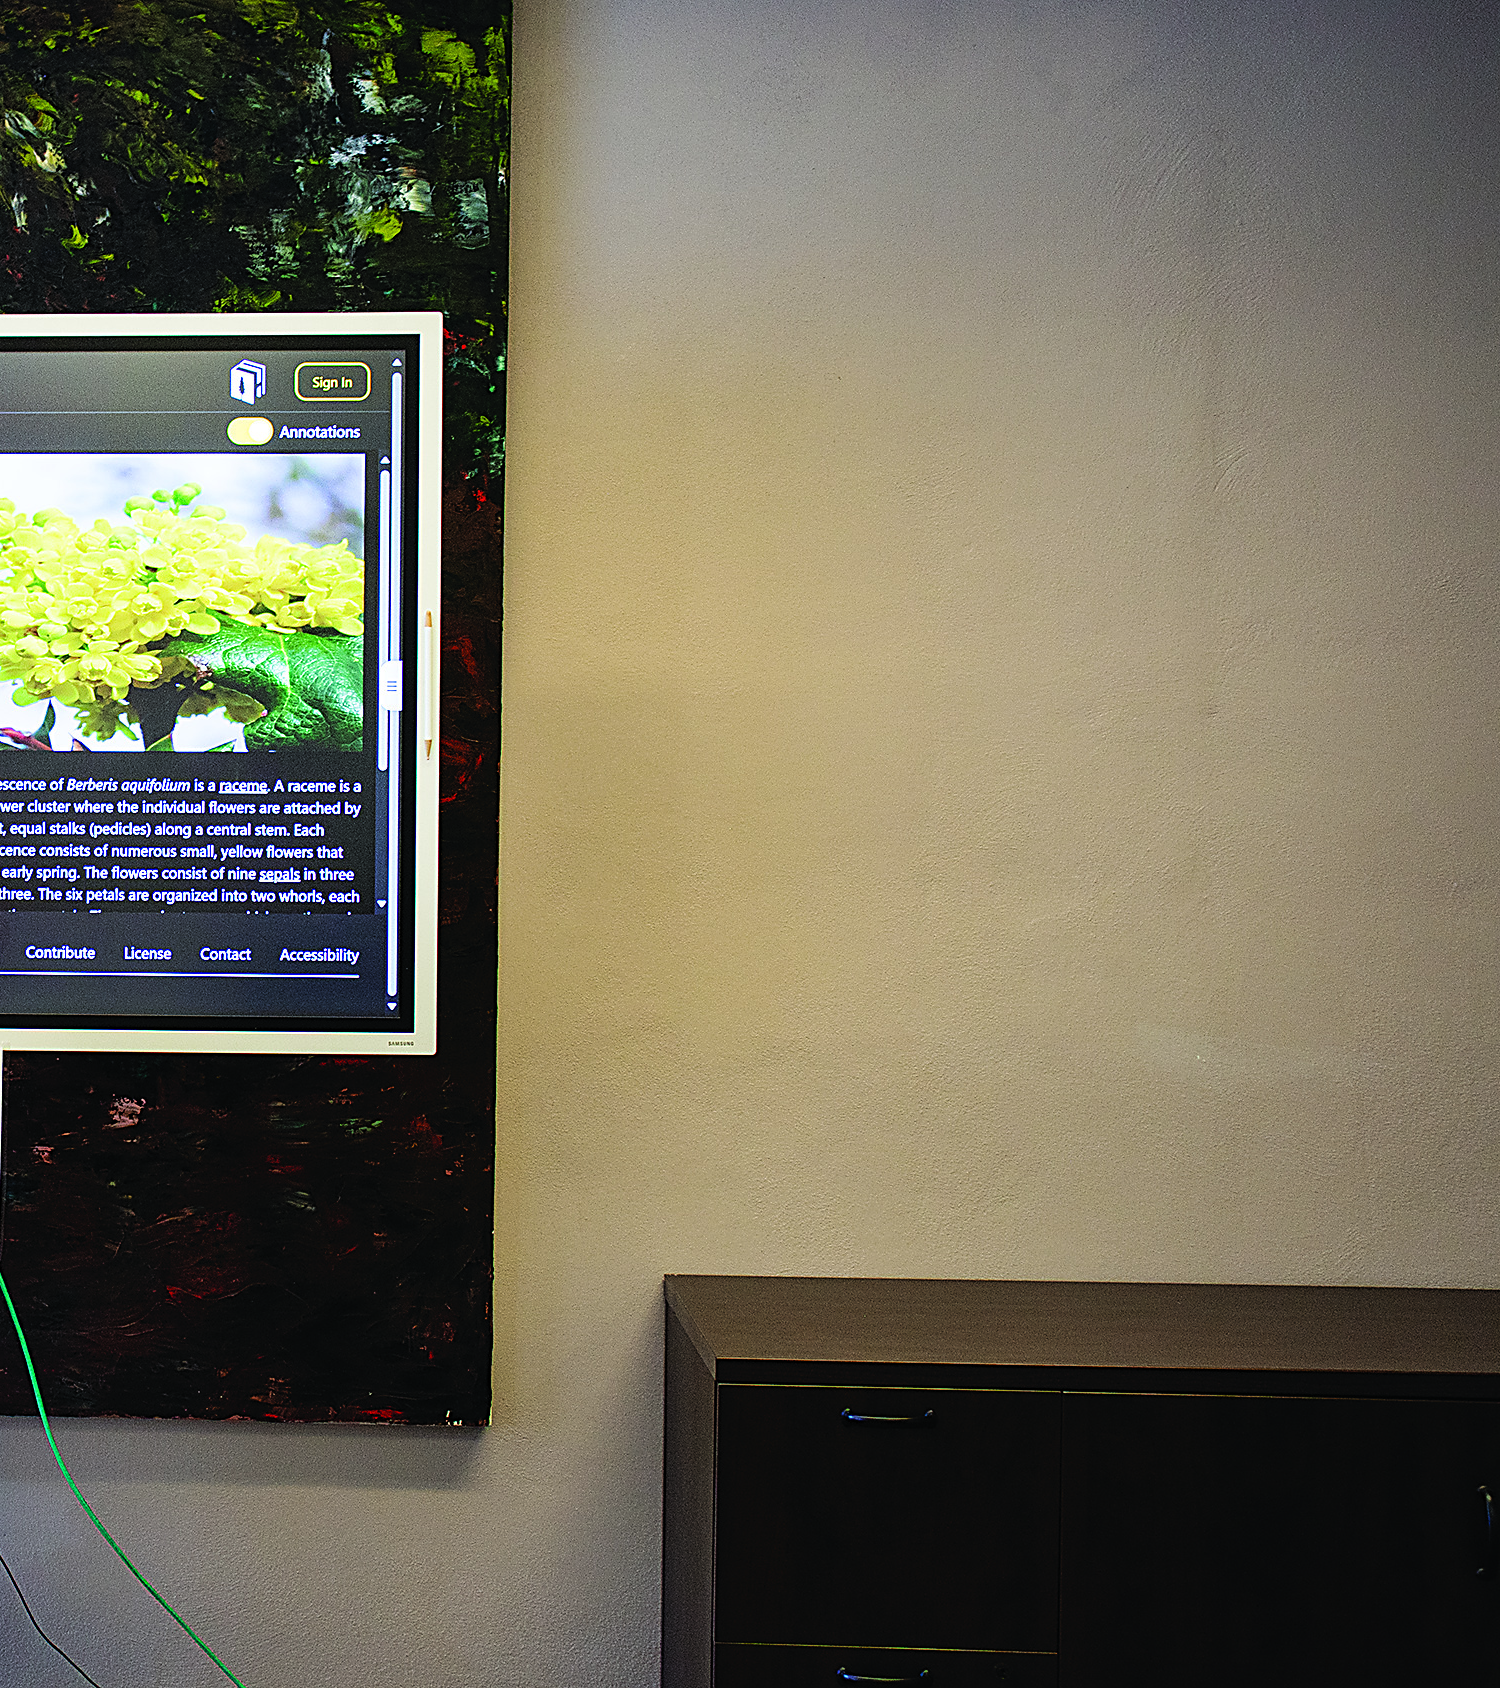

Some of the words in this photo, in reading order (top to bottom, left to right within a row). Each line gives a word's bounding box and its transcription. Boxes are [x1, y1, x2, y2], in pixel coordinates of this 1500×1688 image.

[311, 375, 339, 392] Sign
[340, 376, 353, 389] In
[278, 423, 361, 439] Annotations
[49, 777, 65, 792] of
[66, 777, 119, 792] Berberis
[120, 777, 191, 795] aquifolium
[193, 778, 205, 792] is
[207, 781, 216, 792] a
[218, 781, 271, 795] raceme.
[273, 779, 285, 793] A
[287, 782, 337, 793] raceme
[339, 778, 351, 793] is
[352, 782, 362, 793] a
[26, 799, 72, 813] cluster
[73, 799, 115, 814] where
[116, 799, 140, 814] the
[141, 799, 206, 814] individual
[208, 800, 257, 815] flowers
[258, 803, 281, 815] are
[283, 800, 341, 815] attached
[344, 801, 362, 819] by
[9, 821, 46, 838] equal
[49, 821, 87, 835] stalks
[89, 821, 152, 839] (pedicles)
[154, 821, 192, 840] along
[194, 825, 204, 836] a
[206, 822, 252, 837] central
[254, 823, 291, 837] stem.
[293, 822, 325, 837] Each
[38, 843, 91, 858] consists
[93, 843, 109, 858] of
[111, 846, 178, 858] numerous
[179, 844, 218, 861] small,
[220, 844, 264, 862] yellow
[265, 844, 314, 859] flowers
[316, 845, 344, 859] that
[1, 864, 34, 882] early
[35, 865, 81, 883] spring.
[82, 865, 109, 880] The
[110, 865, 159, 880] flowers
[161, 866, 208, 880] consist
[210, 866, 226, 880] of
[227, 866, 257, 881] nine
[258, 866, 302, 884] sepals
[303, 866, 317, 881] in
[318, 867, 355, 881] three
[37, 886, 63, 901] The
[65, 887, 84, 901] six
[85, 887, 126, 905] petals
[127, 890, 150, 902] are
[152, 888, 218, 905] organized
[221, 888, 248, 903] into
[250, 889, 276, 903] two
[278, 888, 326, 905] whorls,
[328, 889, 360, 904] each
[25, 945, 96, 960] Contribute
[123, 946, 172, 960] License
[199, 947, 252, 961] Contact
[279, 947, 360, 966] Accessibility
